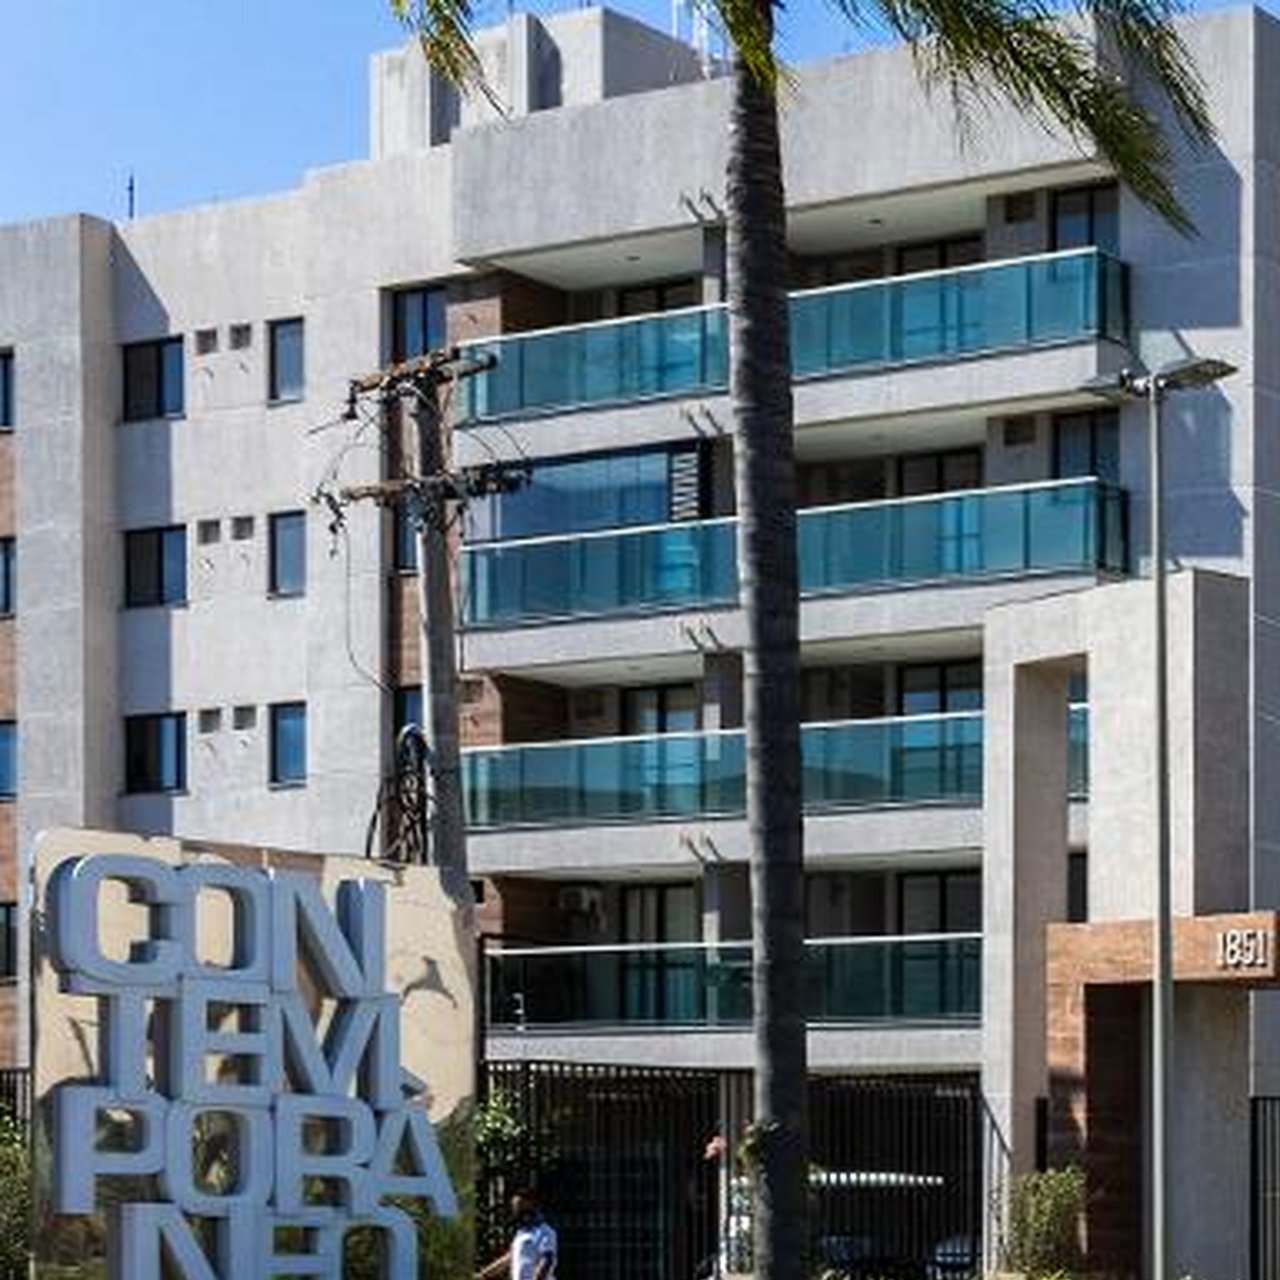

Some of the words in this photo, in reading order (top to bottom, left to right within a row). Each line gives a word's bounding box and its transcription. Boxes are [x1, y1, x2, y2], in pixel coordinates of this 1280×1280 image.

[47, 853, 388, 999] CON
[1215, 929, 1268, 967] 1851
[60, 975, 401, 1110] TEM
[54, 1085, 458, 1217] PORA
